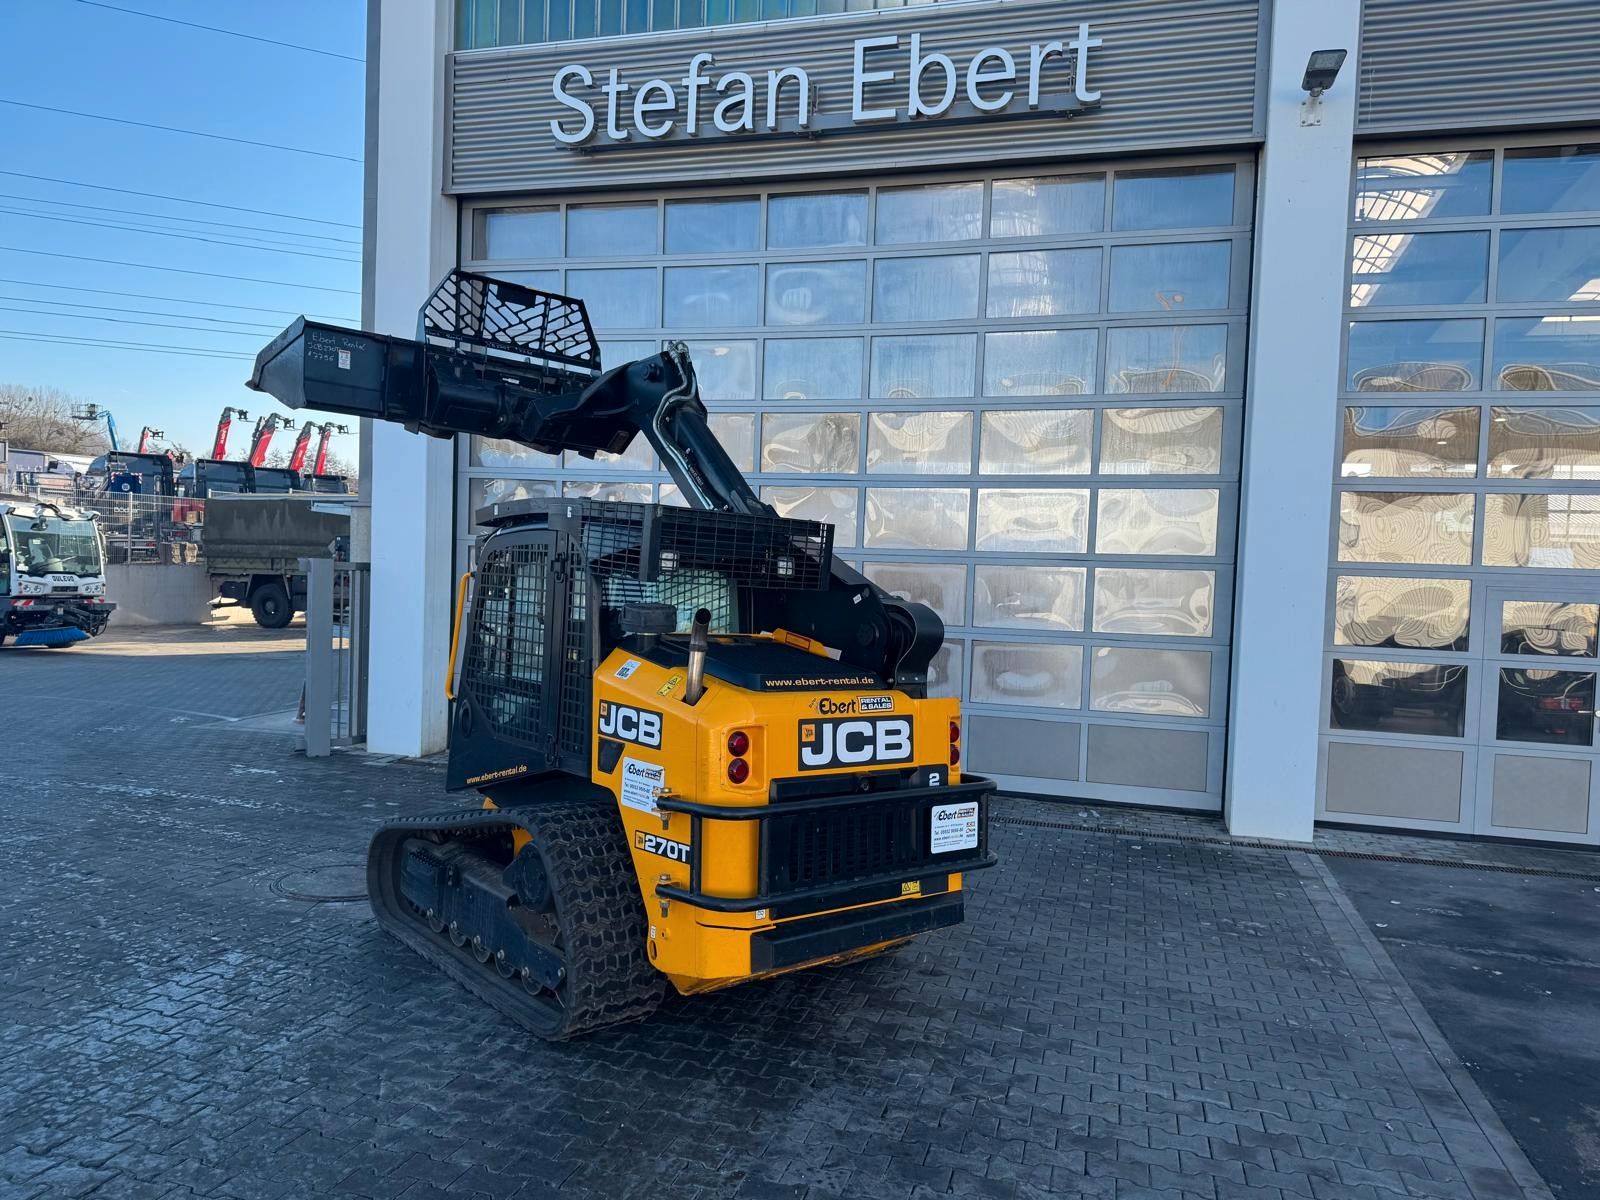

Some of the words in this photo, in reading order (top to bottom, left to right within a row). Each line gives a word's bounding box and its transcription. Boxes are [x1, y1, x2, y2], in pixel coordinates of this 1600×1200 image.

[550, 52, 811, 146] Stefan
[852, 22, 1104, 123] Ebert
[765, 676, 875, 688] www.ebert-rental.de
[818, 697, 857, 715] Ebert
[860, 696, 891, 704] RENTAL
[868, 702, 892, 710] SALES
[599, 704, 661, 746] JCB
[801, 719, 912, 766] JCB
[466, 764, 528, 785] www.ebert-rental.de
[628, 763, 645, 778] Ebert
[928, 772, 940, 787] 2
[938, 809, 958, 821] Ebert
[644, 834, 690, 863] 270T
